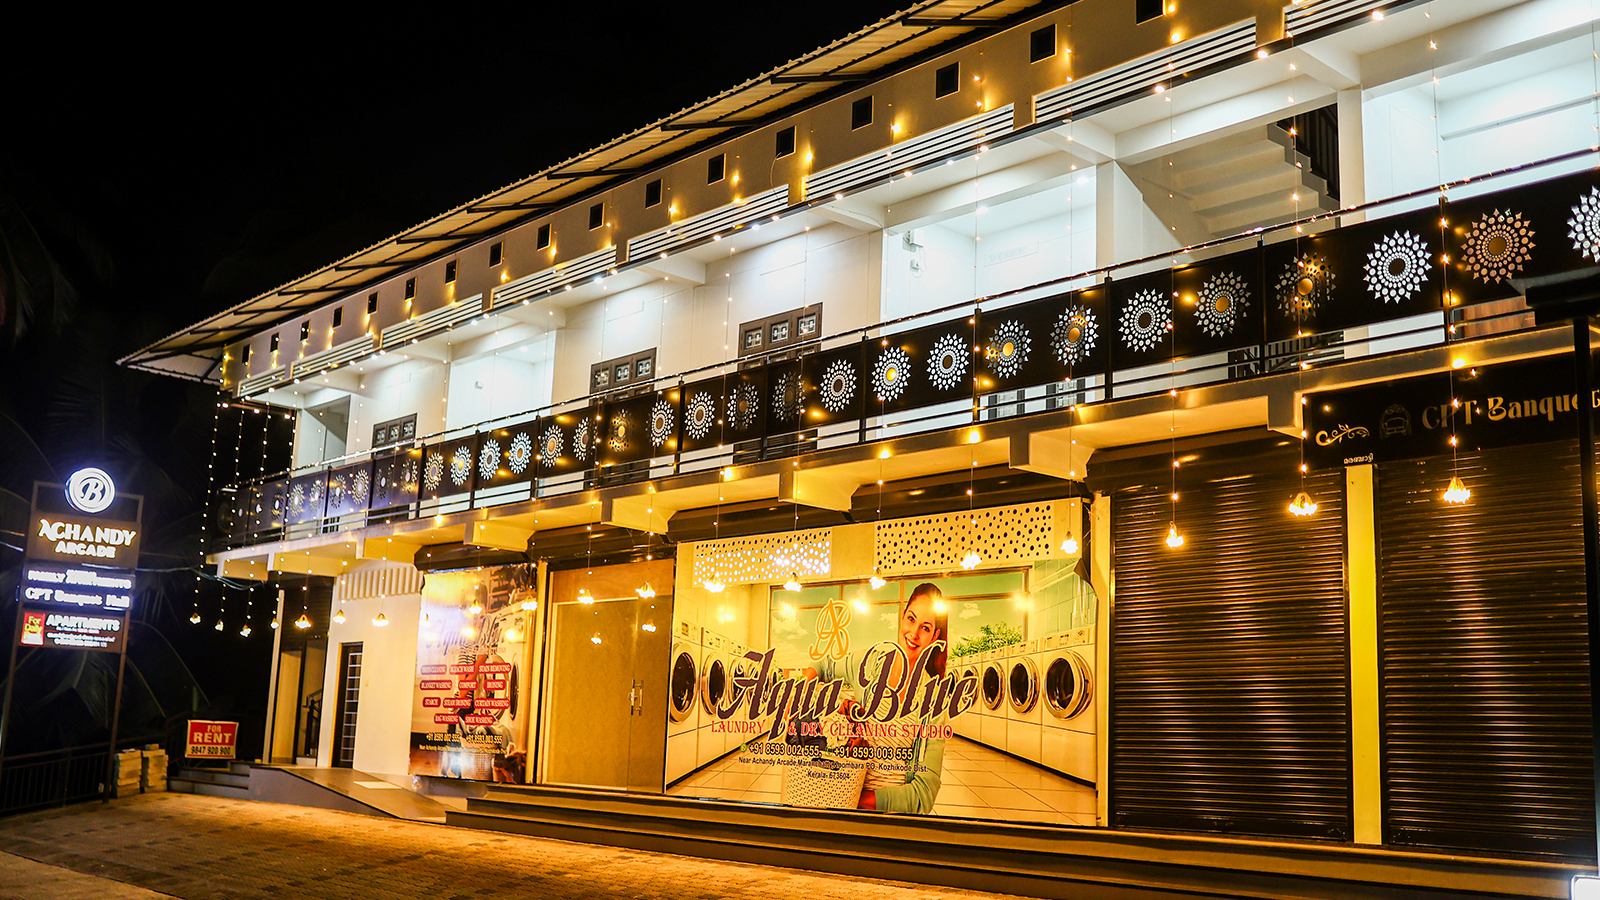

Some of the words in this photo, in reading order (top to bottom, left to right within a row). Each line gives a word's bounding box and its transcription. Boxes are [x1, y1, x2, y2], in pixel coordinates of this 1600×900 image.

[1422, 399, 1478, 430] CPT
[1487, 390, 1600, 422] Banque
[39, 518, 137, 546] ACHANDY
[55, 540, 117, 558] ARCADE
[105, 594, 130, 608] Hall
[28, 615, 42, 625] For
[46, 614, 120, 632] APARTMENTS
[458, 681, 477, 689] COMFORT
[717, 647, 845, 742] Aqua
[850, 640, 979, 722] Blue
[207, 724, 222, 733] FOR
[711, 720, 766, 734] LAUNDRY
[788, 721, 798, 736] &
[800, 720, 828, 736] DRY
[830, 722, 897, 738] CLEANING
[901, 723, 953, 739] STUDIO
[193, 731, 232, 743] RENT
[749, 742, 764, 755] +91
[765, 742, 785, 757] 8593
[787, 744, 802, 757] 002
[834, 745, 850, 758] +91
[852, 746, 874, 759] 8593
[876, 747, 894, 760] 003
[895, 747, 914, 761] 555
[752, 757, 775, 766] Achandy
[879, 762, 912, 771] Kozhikode
